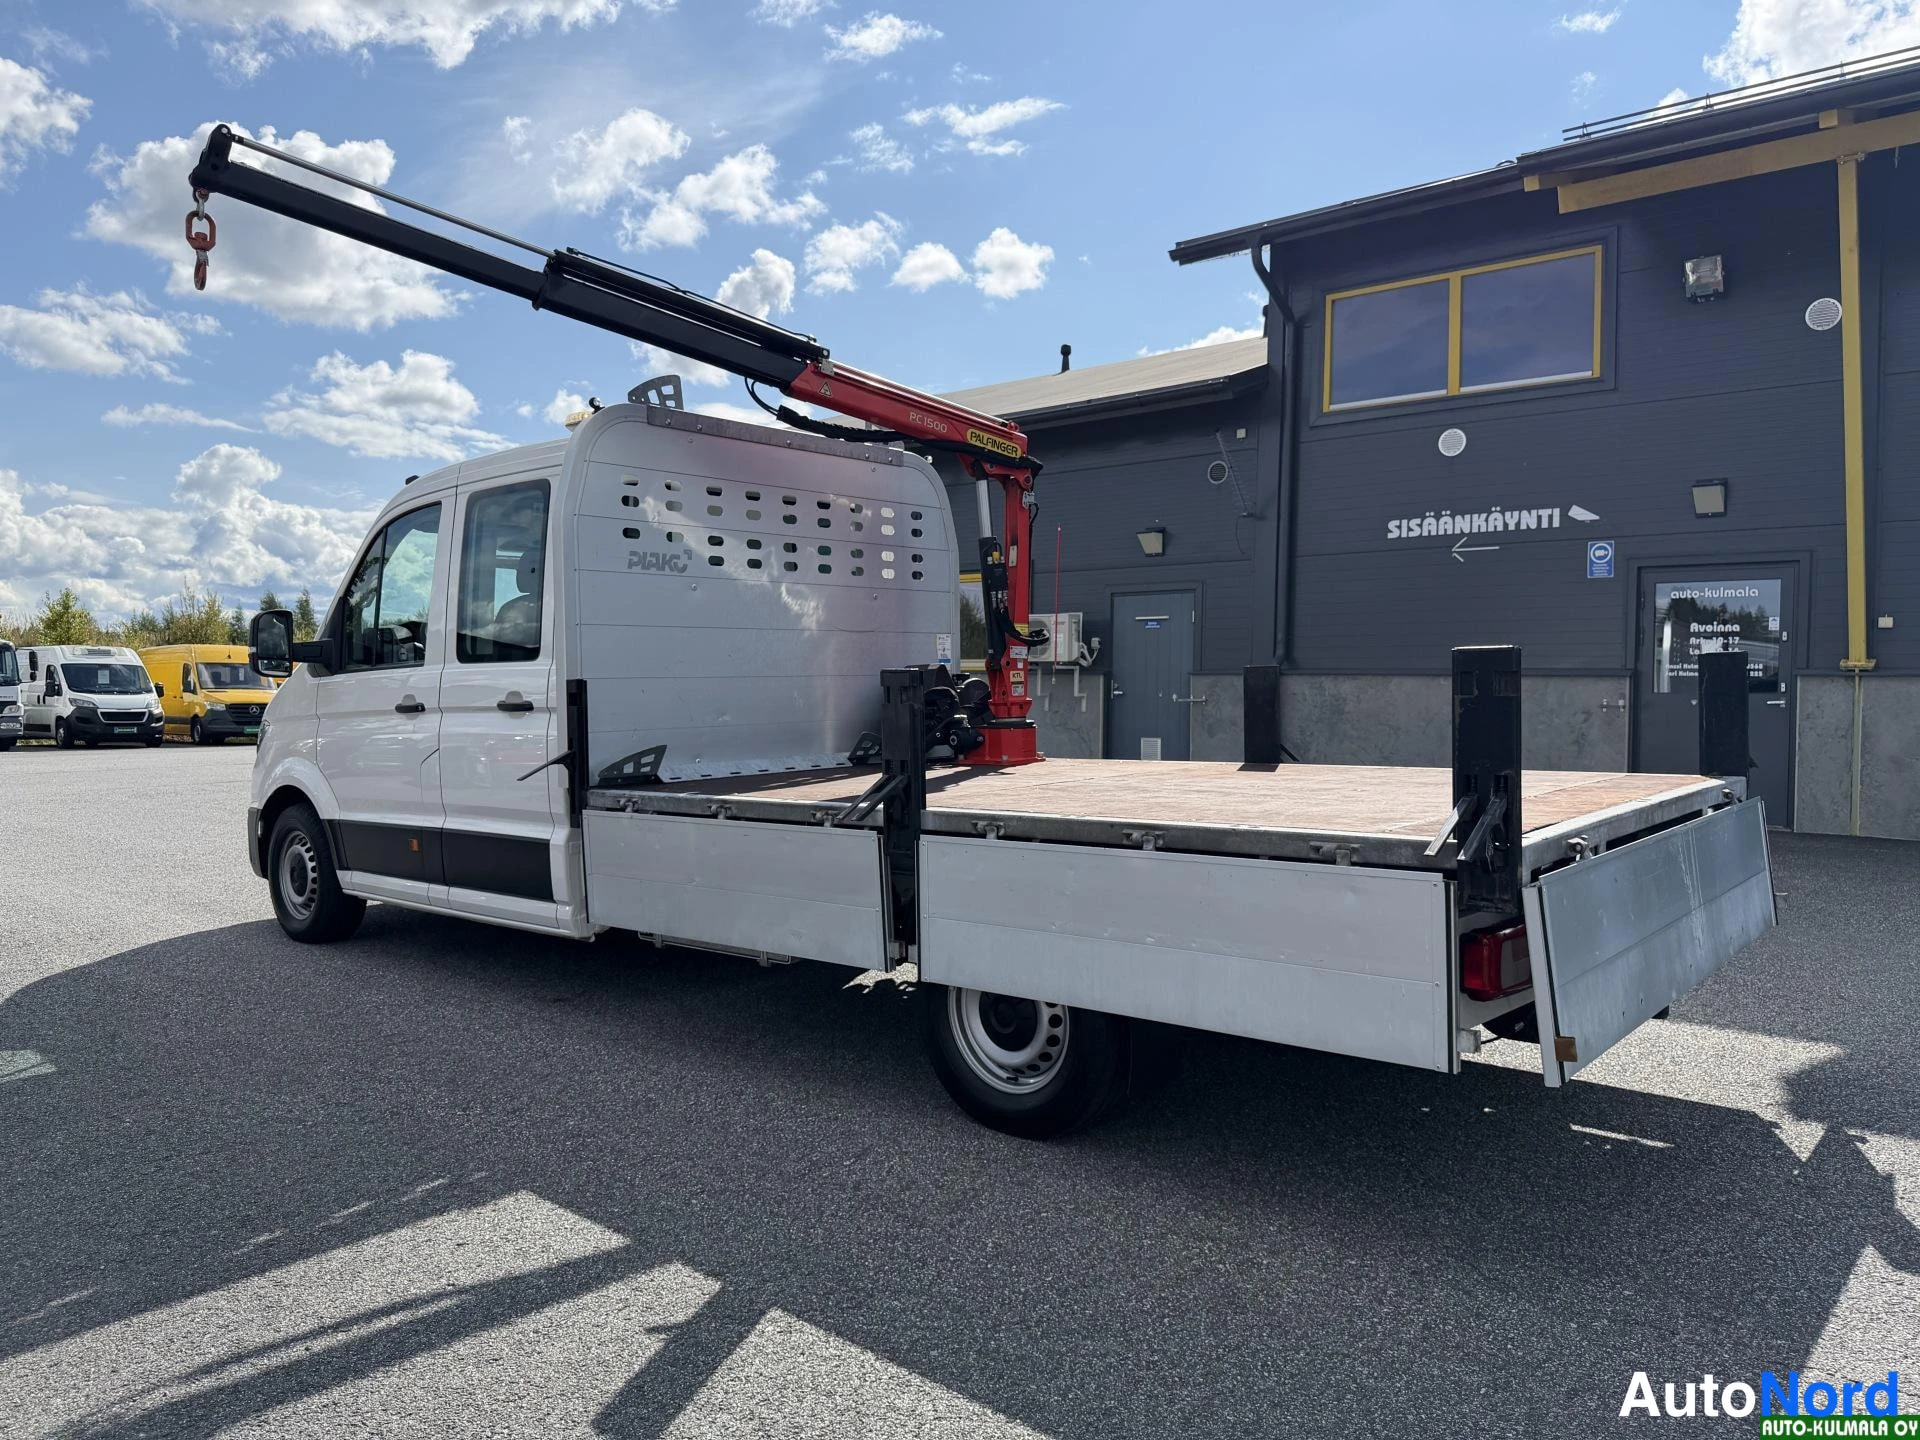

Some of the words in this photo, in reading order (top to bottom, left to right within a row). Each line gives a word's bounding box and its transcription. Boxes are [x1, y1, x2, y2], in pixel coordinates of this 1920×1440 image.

[969, 431, 1018, 457] PALFINGER
[1386, 506, 1561, 539] SISÄÄNKÄYNTI
[1670, 586, 1759, 599] auto-kulmala
[1690, 621, 1740, 633] Avoinna
